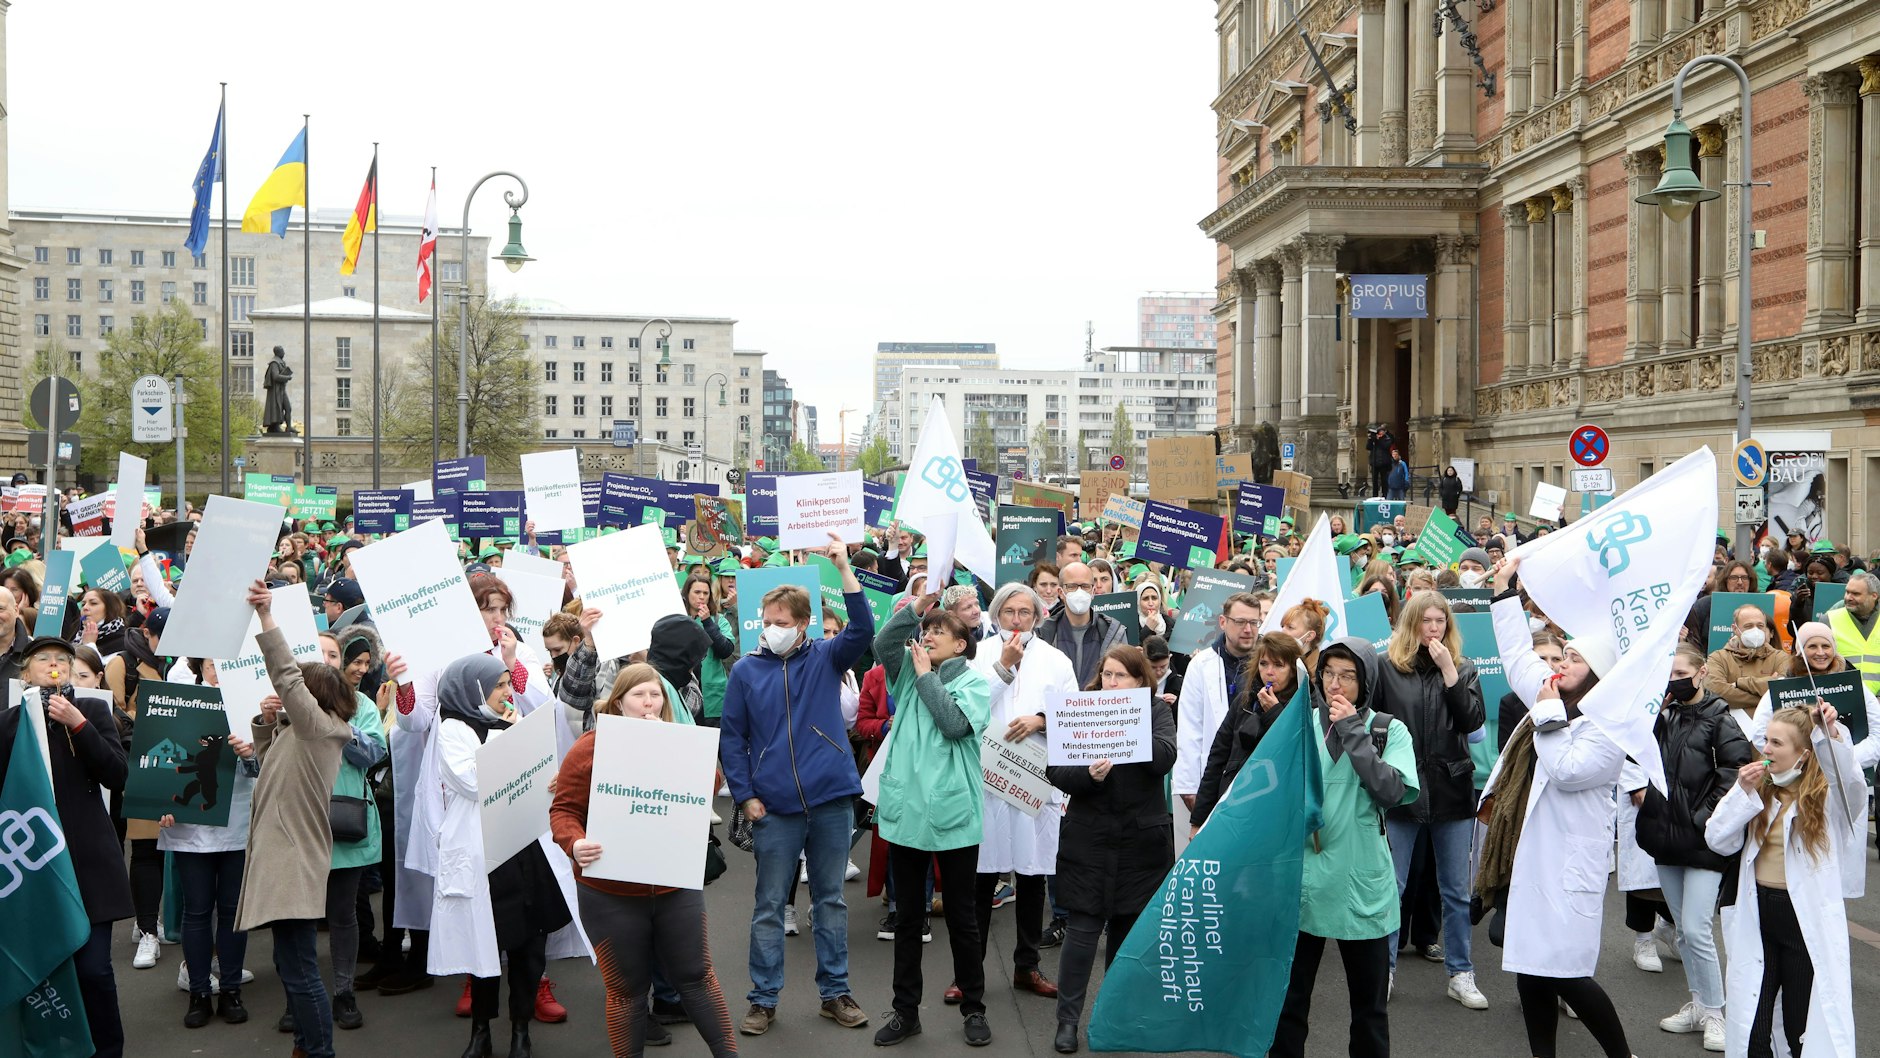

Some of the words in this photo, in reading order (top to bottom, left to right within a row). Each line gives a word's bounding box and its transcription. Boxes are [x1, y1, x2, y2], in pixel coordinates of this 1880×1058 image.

[1352, 284, 1425, 297] GROPIUS
[146, 379, 157, 388] 30
[1284, 445, 1291, 457] P
[437, 466, 469, 474] Modernisierung
[1769, 467, 1806, 483] BAU
[247, 483, 291, 492] Trägervielfalt
[528, 482, 578, 493] #klinikoffensive
[606, 482, 630, 491] Projekte
[1082, 477, 1099, 488] WIR
[1100, 476, 1125, 489] SIND
[545, 491, 562, 499] jetzt!
[606, 489, 658, 503] Energieeinsparung
[1096, 488, 1108, 497] ES
[700, 496, 719, 507] mehr
[796, 495, 851, 508] Klinikpersonal
[301, 506, 326, 515] JETZT!
[463, 506, 519, 514] Krankenpflegeschul
[800, 509, 821, 518] sucht
[822, 508, 848, 517] bessere
[787, 517, 859, 531] Arbeitsbedingungen!
[1002, 515, 1052, 523] #klinikoffensive
[1149, 511, 1176, 526] Projekte
[1176, 519, 1187, 527] zur
[720, 532, 738, 542] mehr
[1147, 520, 1208, 542] Energieeinsparung
[1426, 528, 1453, 553] Wettbewerb
[1197, 550, 1201, 558] 1
[1422, 536, 1436, 549] durch
[1435, 546, 1451, 563] unfaire
[96, 567, 118, 586] KLINIK-
[1197, 575, 1246, 590] #klinikoffensive
[46, 585, 62, 594] KLINIK-
[585, 570, 670, 601] #klinikoffensive
[1194, 581, 1213, 591] jetzt!
[41, 596, 65, 606] OFFENSIVE
[375, 574, 462, 615] #klinikoffensive
[615, 587, 645, 605] jetzt!
[42, 606, 58, 616] JETZT!
[407, 596, 439, 618] jetzt!
[1477, 666, 1502, 676] jetzt!
[1779, 683, 1853, 699] #klinikoffensive
[148, 694, 227, 712] #klinikoffensiv
[1065, 696, 1096, 707] Politik
[1097, 695, 1132, 706] fordert:
[146, 704, 177, 718] jetzt!
[1056, 708, 1119, 719] Mindestmengen
[1129, 706, 1142, 714] der
[1058, 717, 1141, 728] Patientenversorgung!
[1072, 730, 1088, 739] Wir
[1091, 729, 1127, 738] fordern:
[983, 735, 1001, 752] ETZT
[1062, 740, 1125, 752] Mindestmengen
[1126, 739, 1138, 747] bei
[1067, 751, 1081, 760] der
[1082, 750, 1134, 761] Finanzierung!
[996, 759, 1010, 772] für
[1009, 768, 1022, 779] ein
[483, 753, 554, 808] #klinikoffensive
[508, 779, 533, 806] jetzt!
[596, 782, 707, 806] #klinikoffensive
[1008, 784, 1043, 810] BERLIN
[630, 800, 668, 816] jetzt!
[1202, 860, 1223, 955] Berliner
[1159, 858, 1185, 1003] Gesellschaft
[1181, 859, 1204, 1012] Krankenhaus
